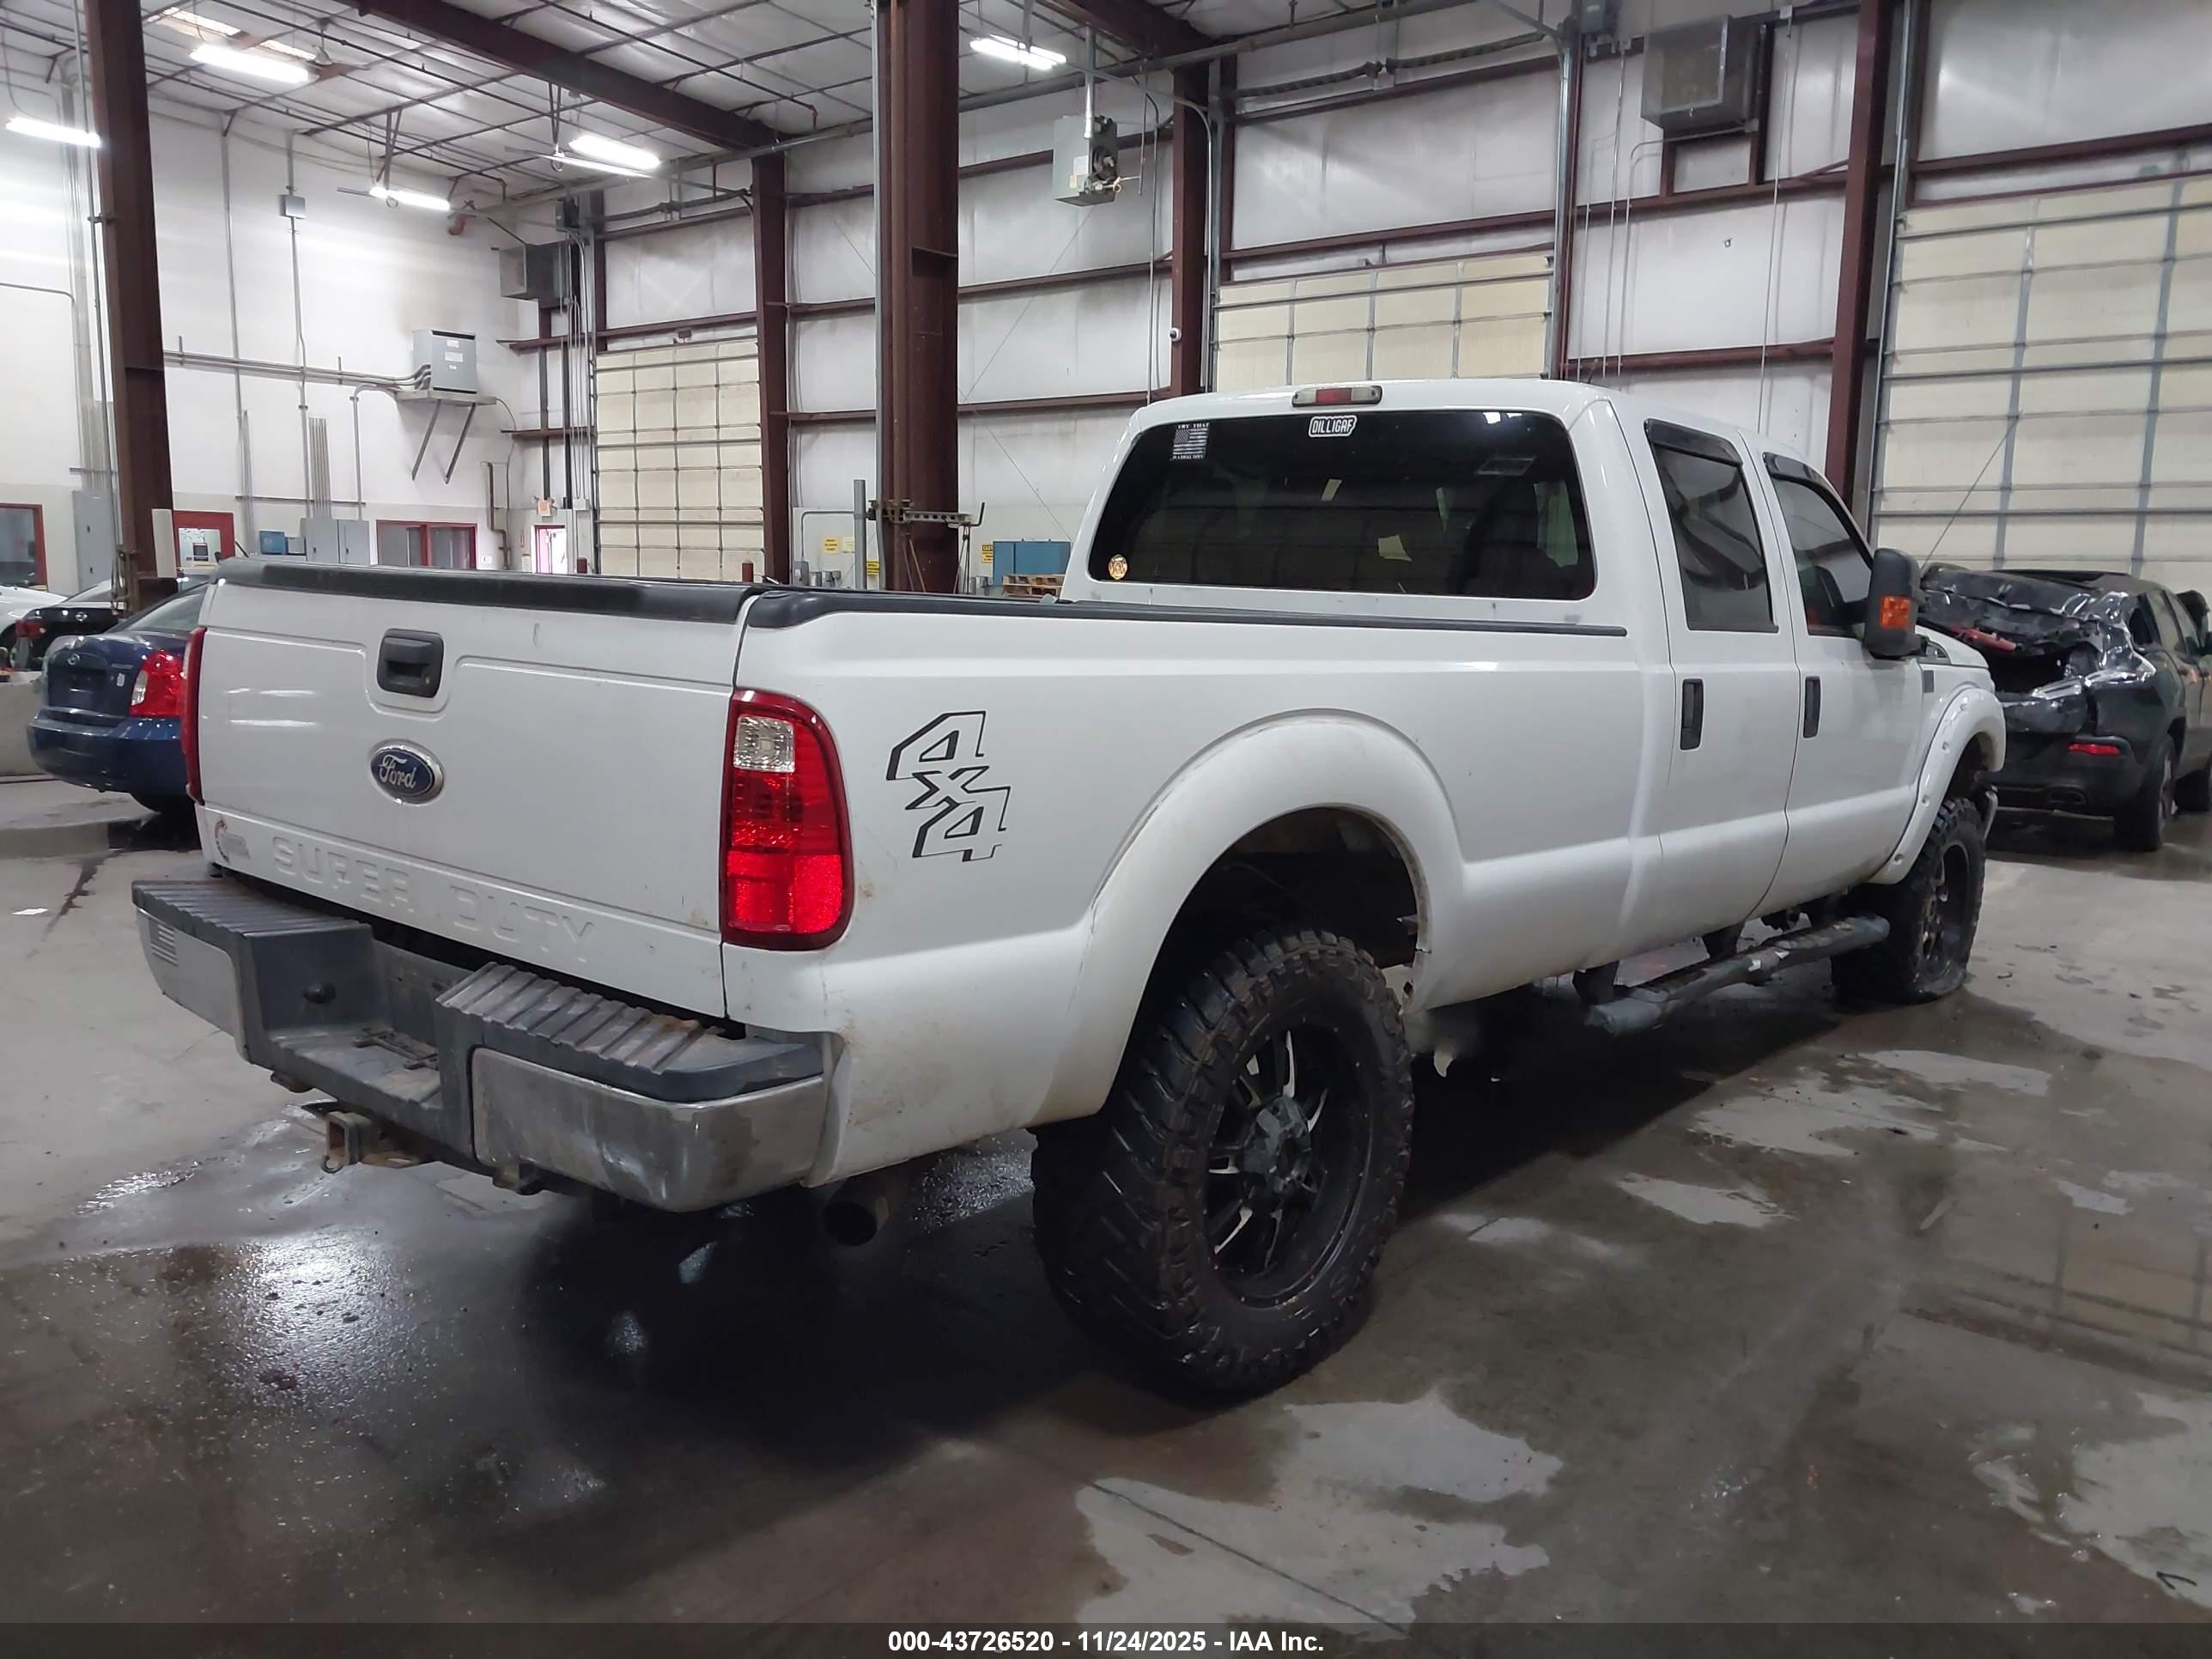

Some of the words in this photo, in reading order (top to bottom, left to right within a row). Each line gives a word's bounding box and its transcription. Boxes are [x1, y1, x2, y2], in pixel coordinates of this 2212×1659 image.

[1311, 418, 1354, 434] DILLIGAF
[379, 754, 417, 789] Ford
[272, 836, 416, 914] SUPER
[449, 884, 596, 963] DUTY
